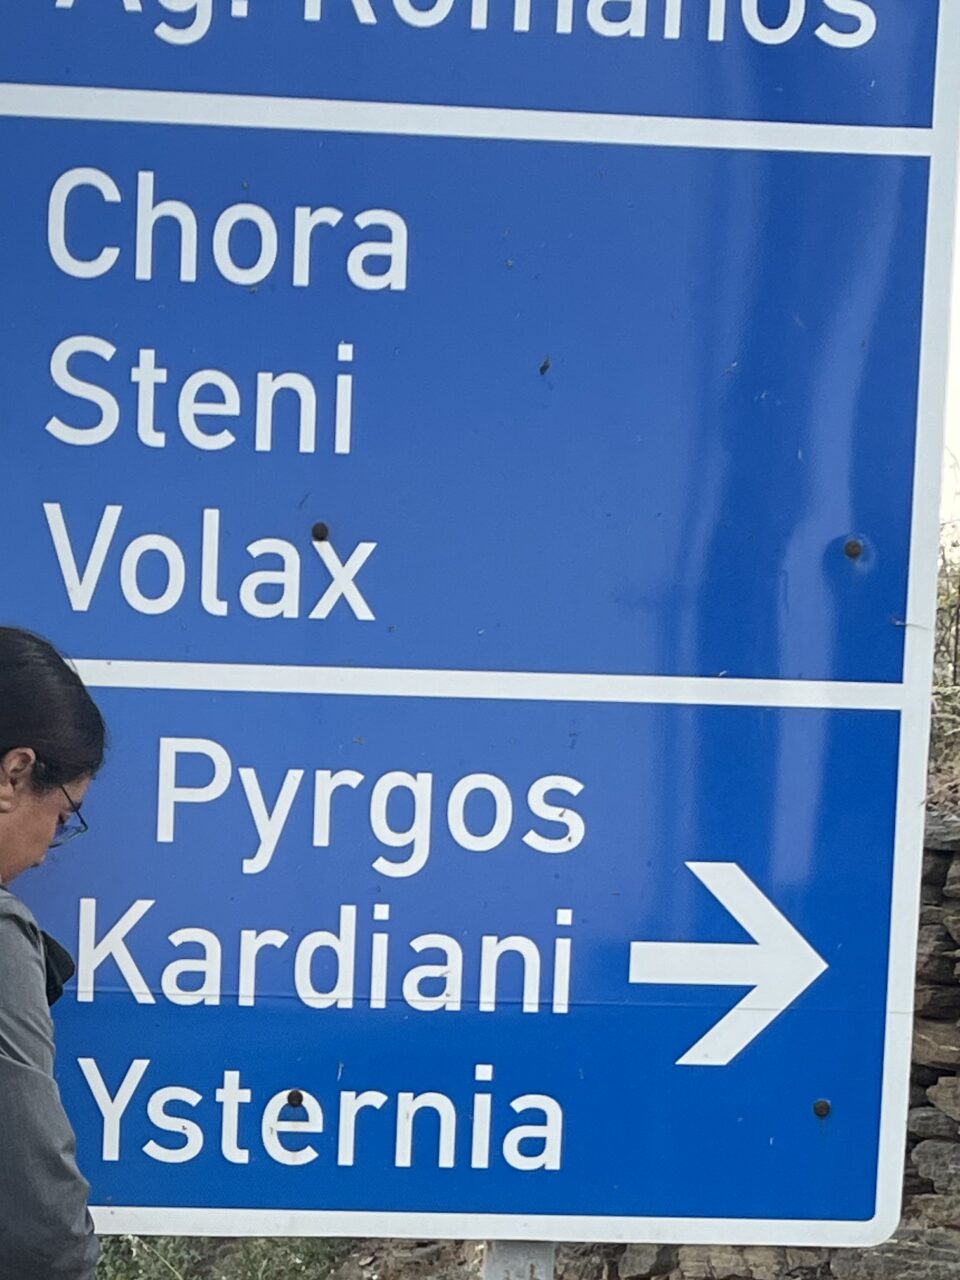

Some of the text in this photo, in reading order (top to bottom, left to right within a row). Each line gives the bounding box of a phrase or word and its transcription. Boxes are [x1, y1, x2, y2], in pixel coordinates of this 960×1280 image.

[48, 167, 408, 291] Chora
[45, 335, 354, 455] Steni
[44, 502, 378, 621] Volax
[156, 736, 587, 878] Pyrgos
[76, 898, 574, 1015] Kardiani
[77, 1057, 564, 1171] Ysternia
